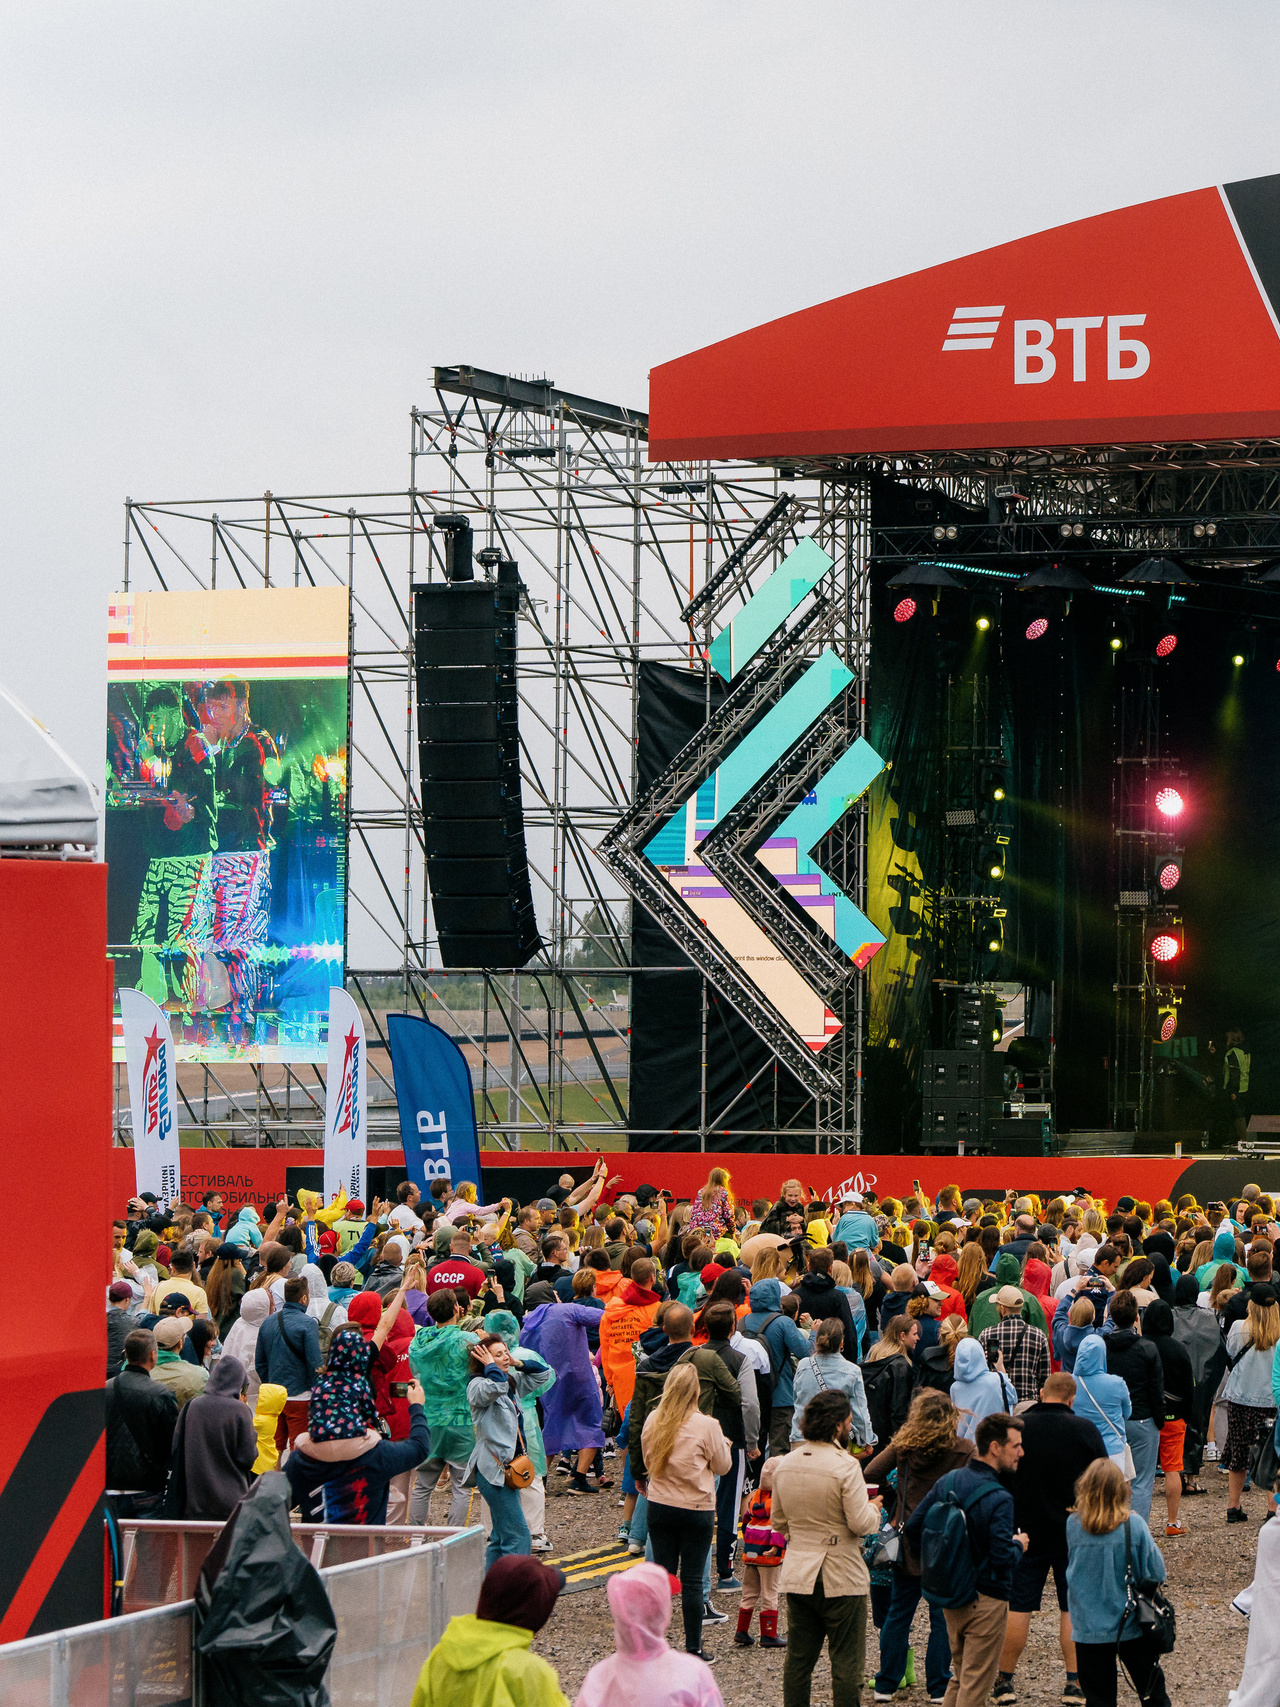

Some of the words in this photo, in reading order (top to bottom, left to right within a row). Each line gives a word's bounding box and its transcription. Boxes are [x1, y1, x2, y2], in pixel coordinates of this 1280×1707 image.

[1013, 313, 1151, 385] ВТБ
[180, 1175, 254, 1187] ЕСТИВАЛЬ
[434, 1272, 465, 1284] СССР
